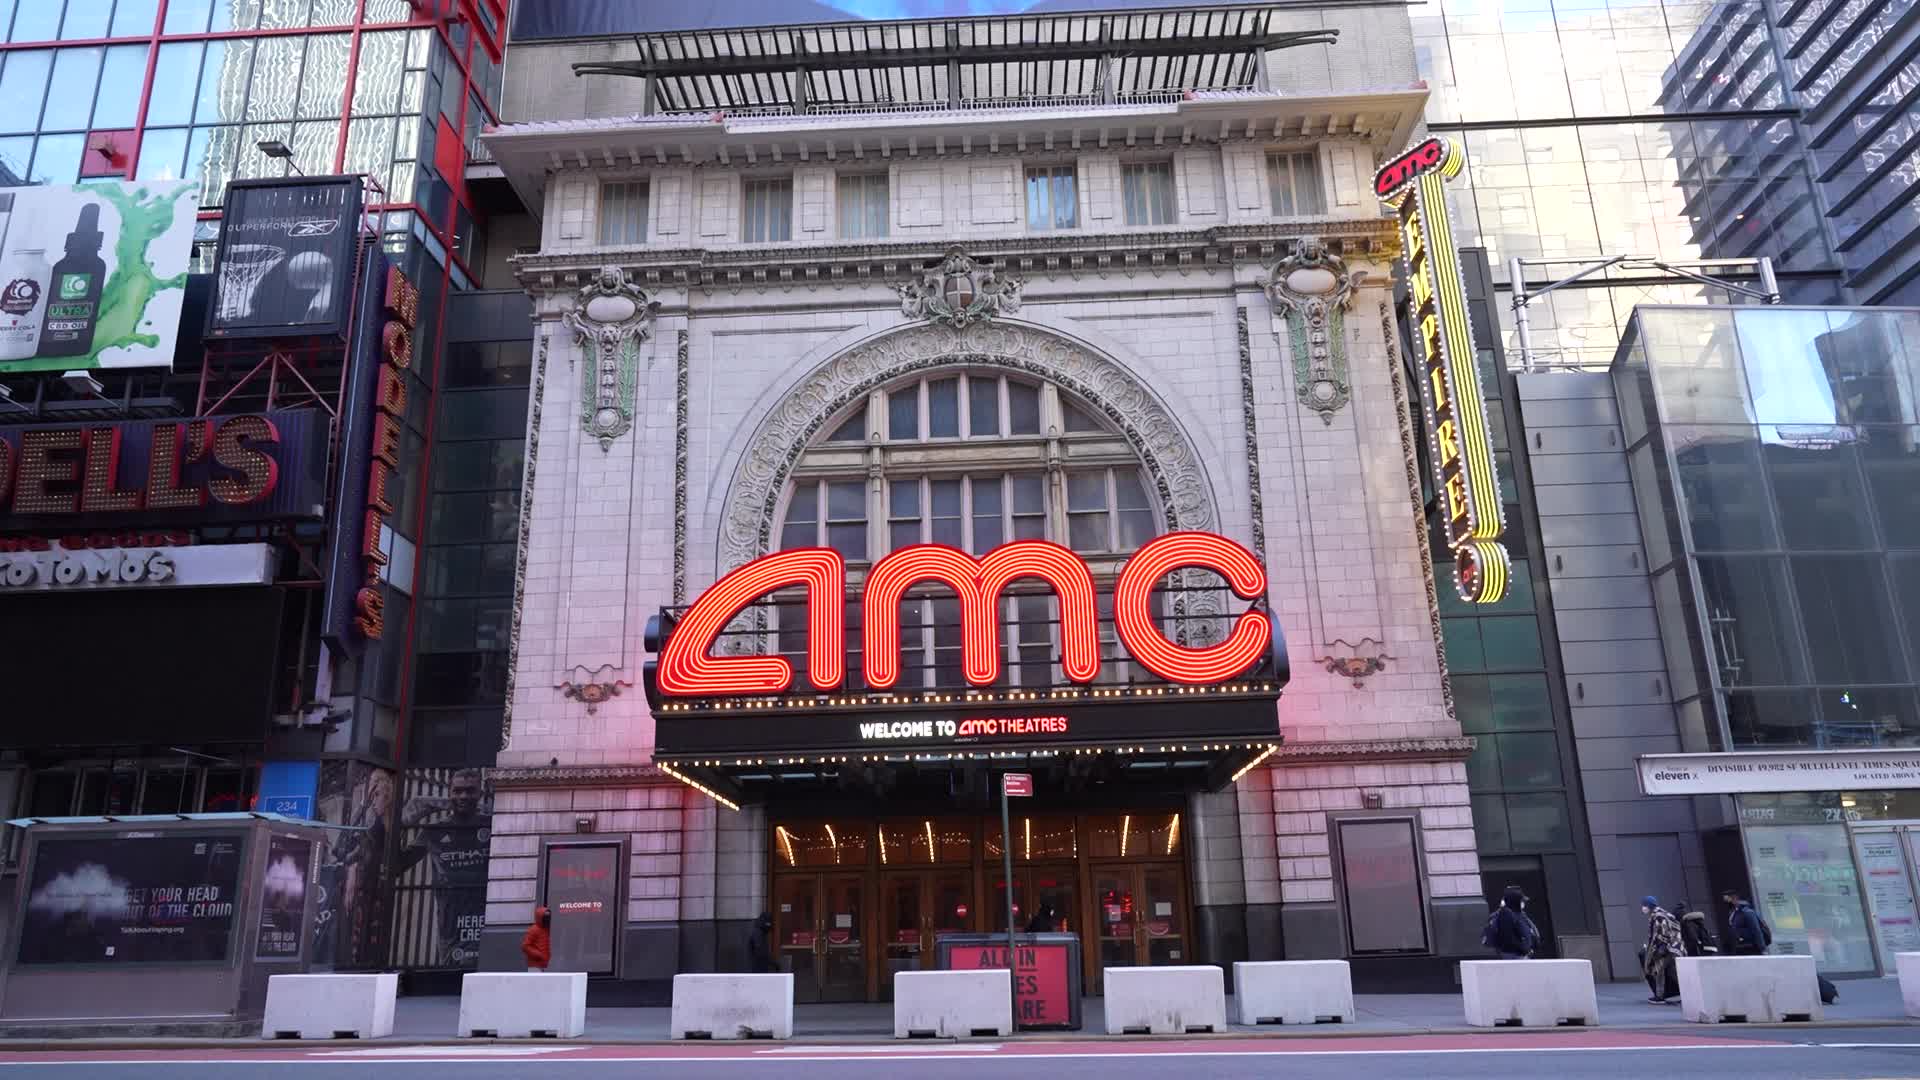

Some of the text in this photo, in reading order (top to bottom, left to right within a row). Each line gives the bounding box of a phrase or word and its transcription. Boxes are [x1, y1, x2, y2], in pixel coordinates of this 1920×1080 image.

[1377, 142, 1441, 194] amc
[1404, 210, 1467, 523] EMPIRE
[0, 415, 280, 514] ELL'S
[656, 531, 1271, 695] amc
[860, 716, 1067, 739] WELCOME TO amc THEATRES
[1655, 771, 1690, 780] eleven
[151, 887, 182, 902] YOUR
[187, 886, 219, 901] HEAD
[167, 903, 189, 917] THE
[1018, 949, 1036, 967] IN
